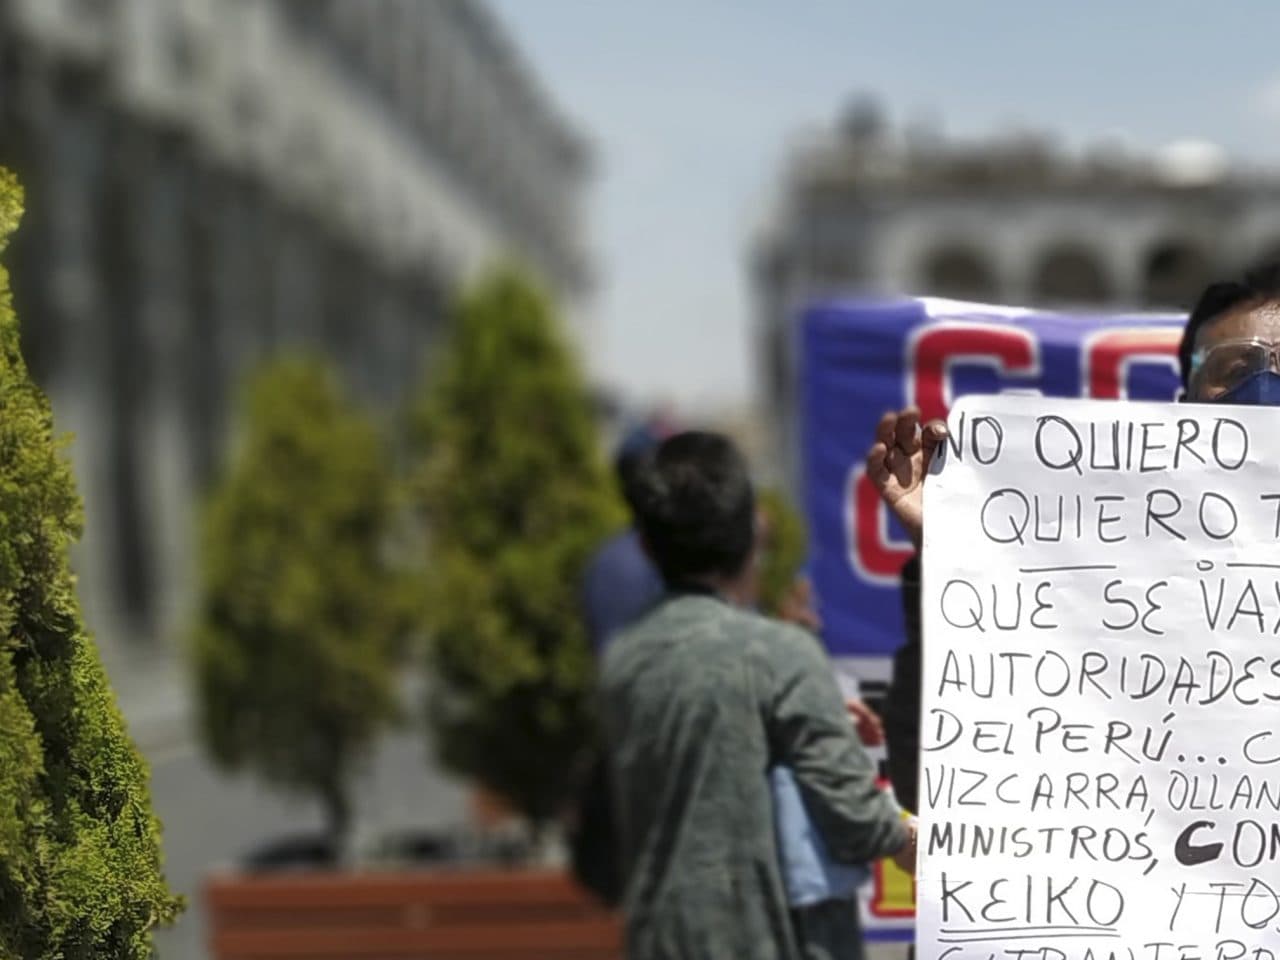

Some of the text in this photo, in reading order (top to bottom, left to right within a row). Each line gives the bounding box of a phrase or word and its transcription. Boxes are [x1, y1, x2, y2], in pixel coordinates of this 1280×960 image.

[1034, 415, 1250, 476] QUIERO
[980, 488, 1239, 545] QUIERO
[939, 579, 1058, 633] QUE
[1099, 580, 1169, 635] SE
[923, 708, 1015, 754] DEL
[940, 870, 1125, 928] KEIKO
